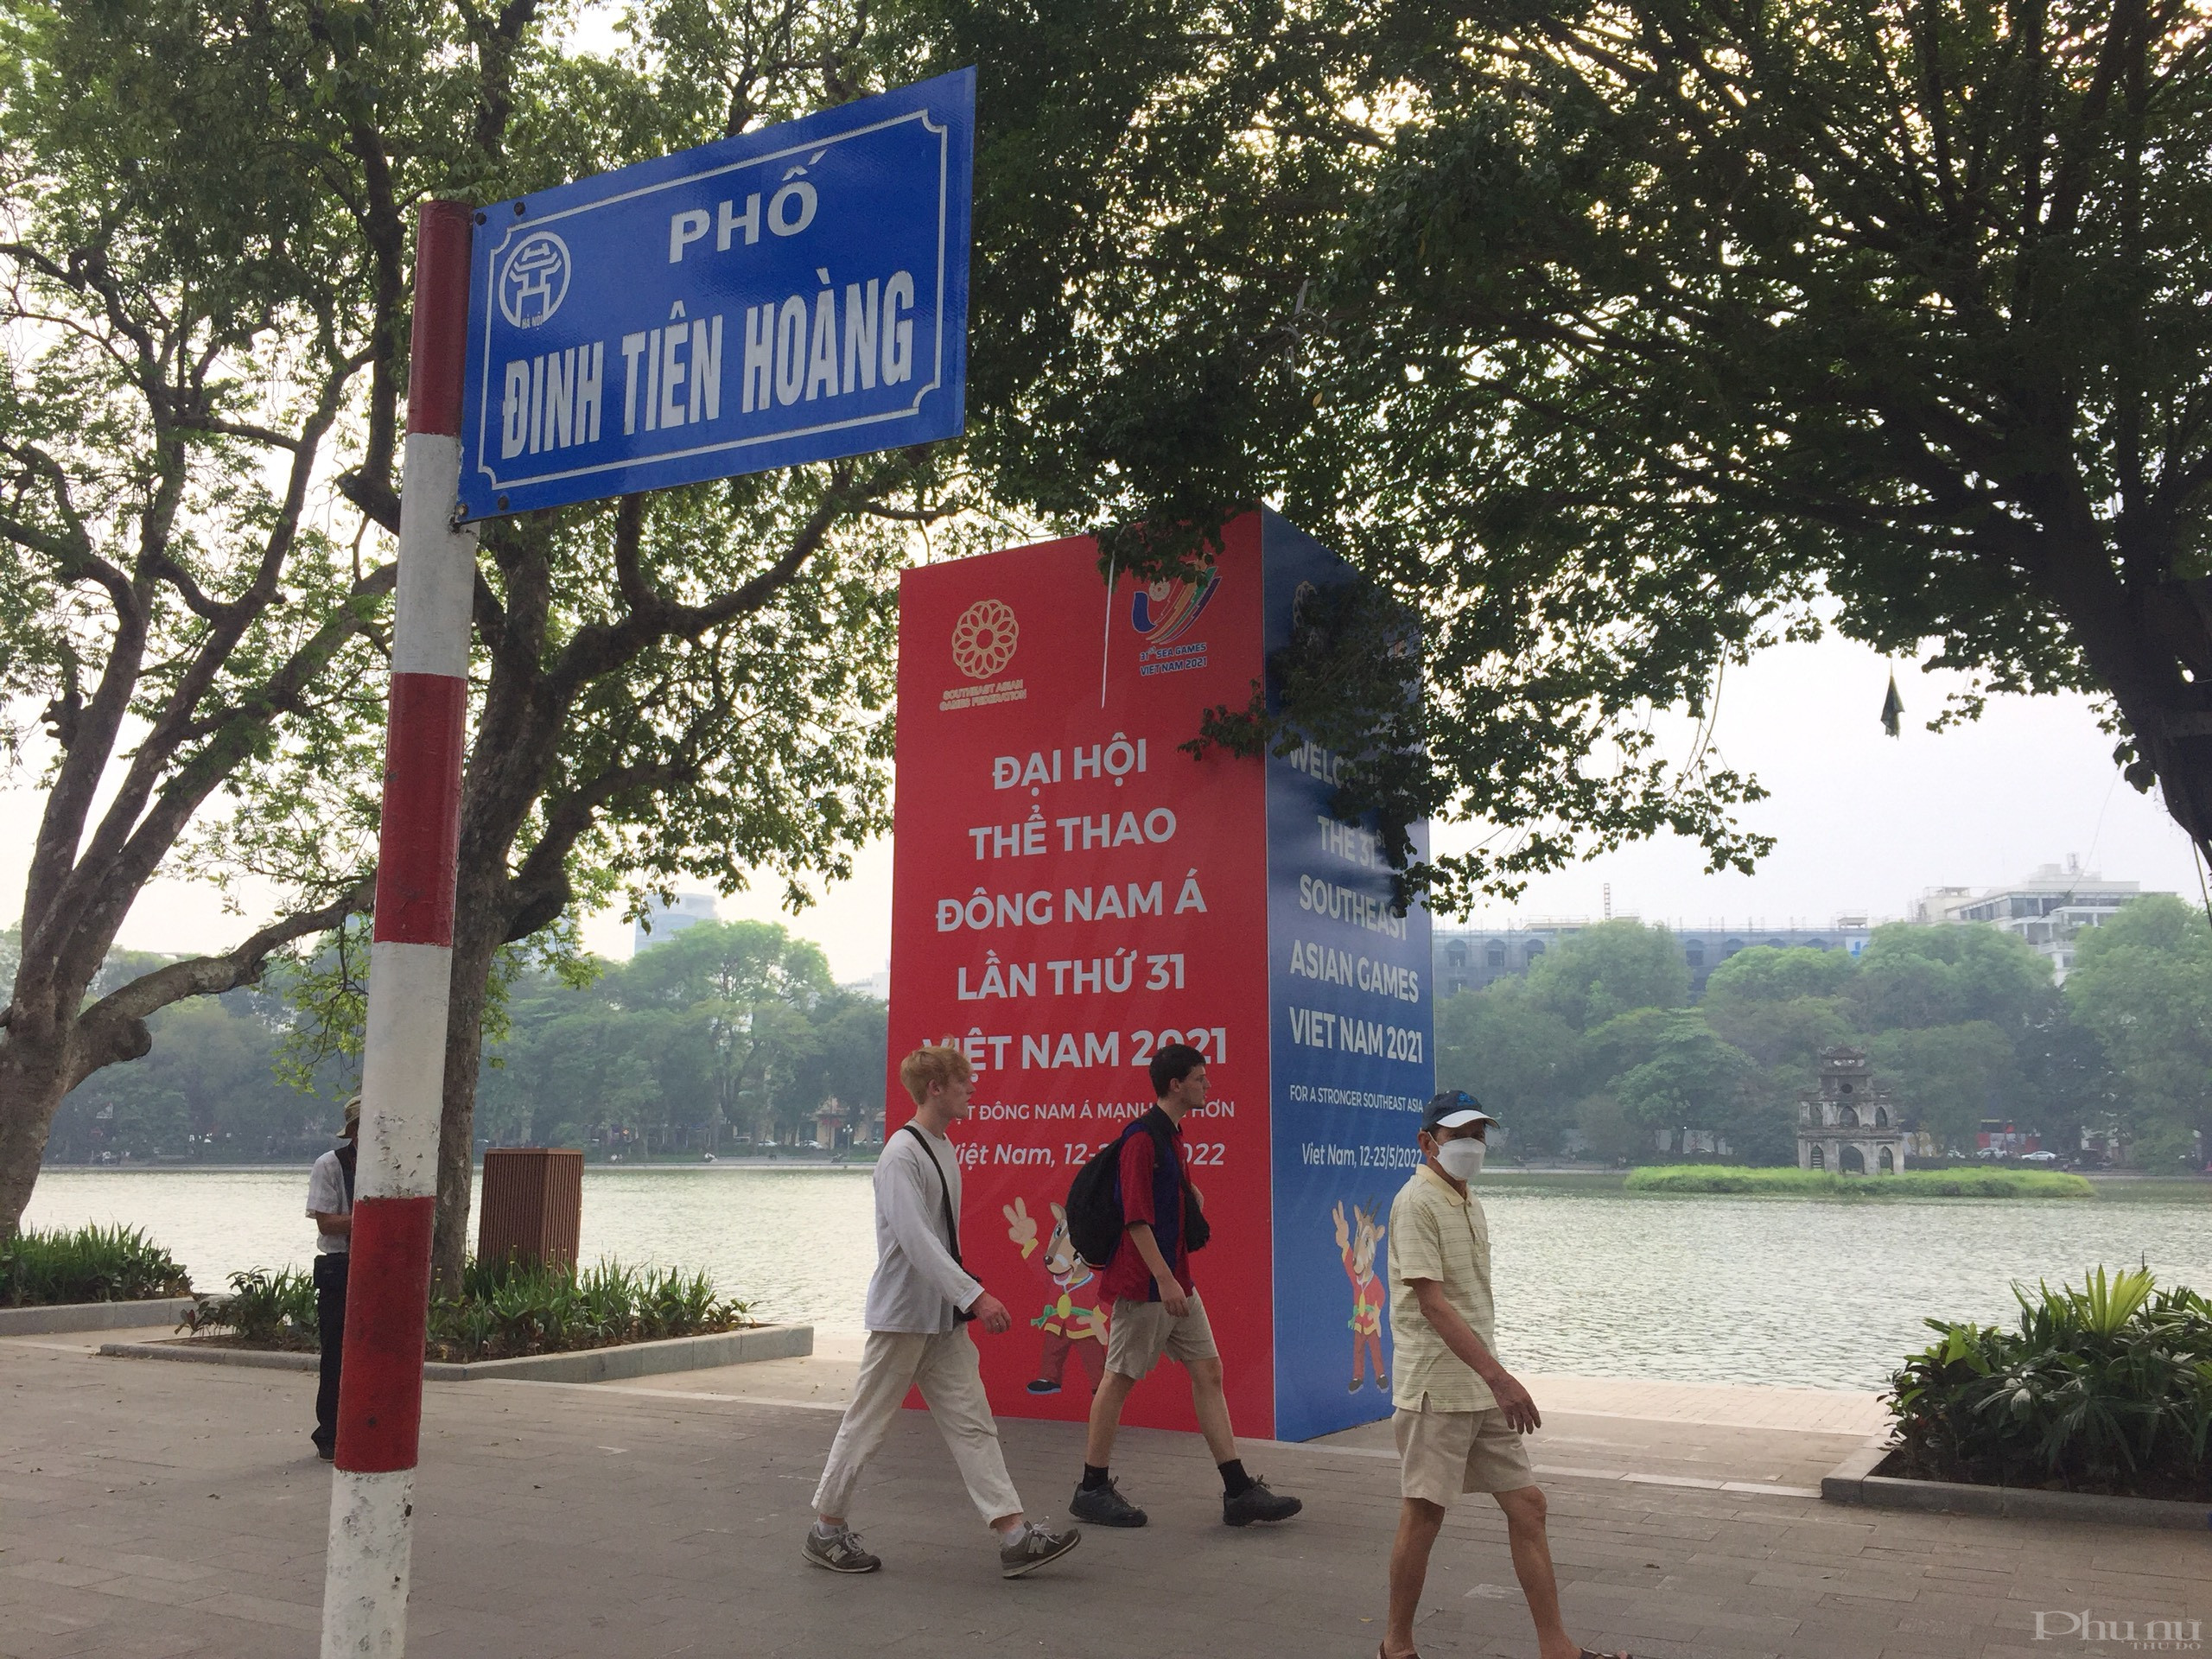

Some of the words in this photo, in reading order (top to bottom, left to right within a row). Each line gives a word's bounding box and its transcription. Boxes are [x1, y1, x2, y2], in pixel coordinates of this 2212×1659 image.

[670, 150, 824, 264] PHỐ
[501, 341, 604, 460] ĐINH
[622, 301, 721, 435] TIÊN
[742, 268, 914, 413] HOÀNG
[1140, 664, 1160, 677] VIET
[1160, 659, 1184, 673] NAM
[1185, 656, 1208, 671] 2021
[1156, 648, 1174, 658] SEA
[1175, 642, 1207, 656] GAMES
[992, 749, 1061, 797] ĐẠI
[1073, 731, 1147, 787] HỘI
[969, 804, 1046, 860] THỂ
[1056, 807, 1177, 852] THAO
[1318, 815, 1356, 862] THE
[935, 887, 1053, 932] ĐÔNG
[1065, 880, 1163, 923] NAM
[1173, 868, 1208, 914] Á
[1300, 874, 1408, 940] SOUTHEAST
[957, 950, 1036, 1001] LẦN
[1047, 947, 1137, 995] THỨ
[1146, 953, 1185, 990] 31
[1289, 939, 1353, 988] ASIAN
[1357, 957, 1419, 1003] GAMES
[1022, 1031, 1120, 1070] NAM
[1288, 1007, 1336, 1049] VIET
[1340, 1016, 1383, 1058] NAM
[1386, 1026, 1423, 1065] 2021
[979, 1101, 1030, 1120] ĐÔNG
[1034, 1103, 1075, 1120] NAM
[1079, 1099, 1093, 1119] Á
[1289, 1084, 1308, 1103] FOR
[1309, 1087, 1316, 1103] A
[1317, 1087, 1363, 1107] STRONGER
[1363, 1092, 1406, 1111] SOUTHEAST
[1407, 1098, 1424, 1113] ASIA
[994, 1143, 1056, 1167] Nam,
[1301, 1141, 1325, 1166] Viet
[1327, 1143, 1357, 1168] Nam,
[1359, 1144, 1422, 1170] 12-23/5/2022
[825, 1544, 848, 1563] N
[1028, 1536, 1047, 1554] N
